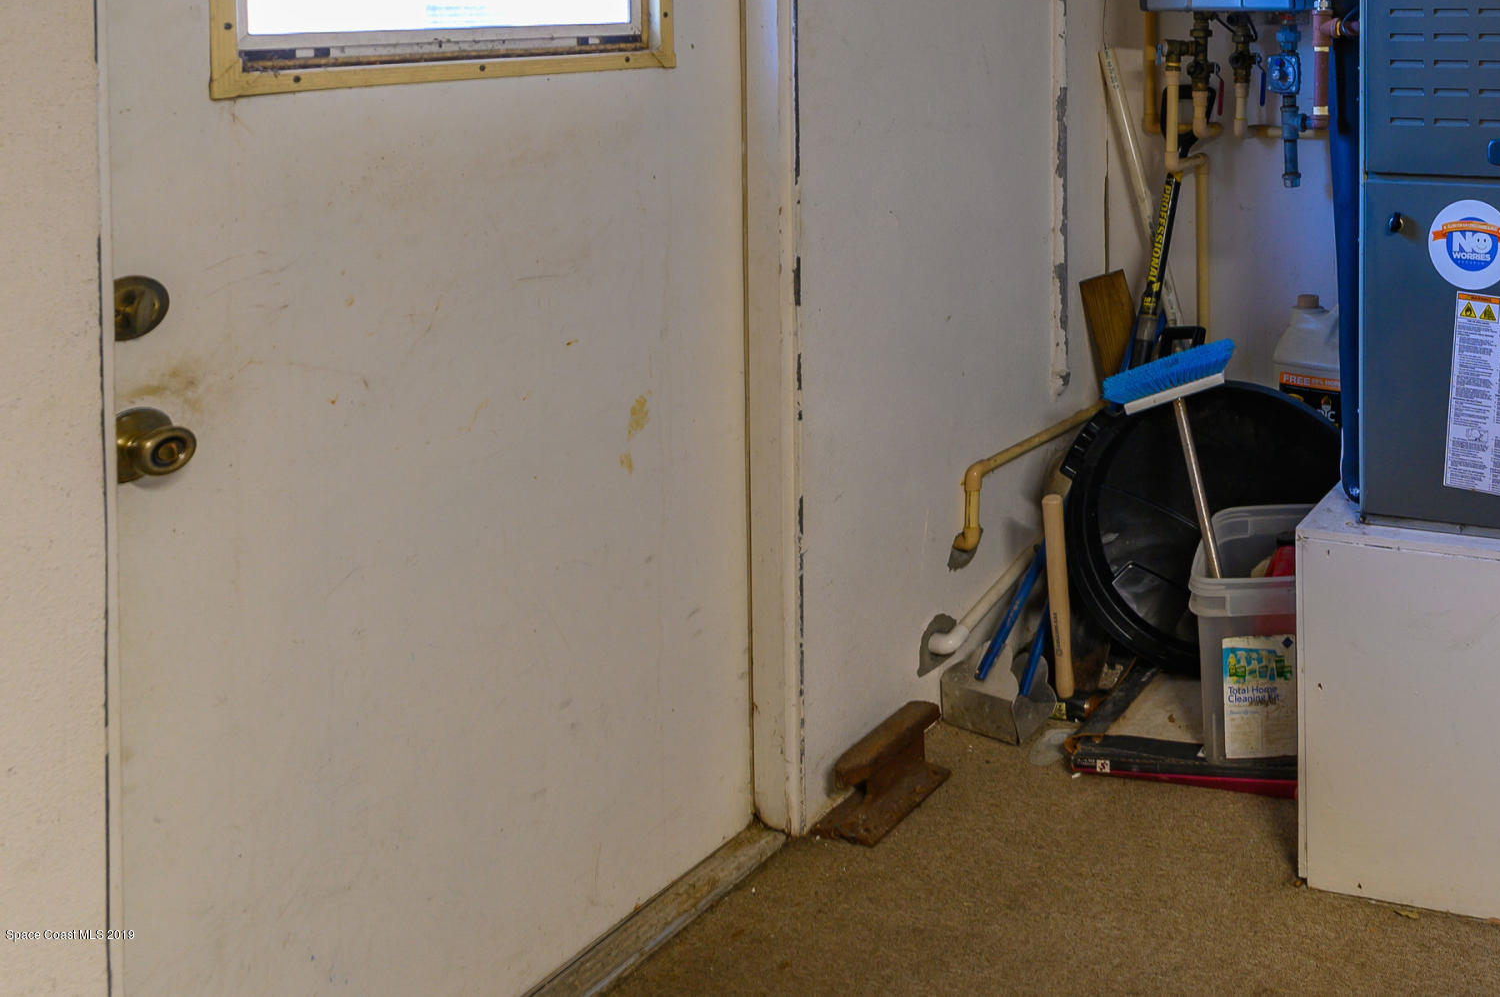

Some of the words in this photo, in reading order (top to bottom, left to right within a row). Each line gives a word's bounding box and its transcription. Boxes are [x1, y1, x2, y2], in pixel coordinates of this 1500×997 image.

[1148, 185, 1172, 283] PROFESSIONAL
[1452, 231, 1493, 254] NO
[1452, 251, 1491, 261] WORRIES
[1283, 373, 1311, 386] FREE
[1228, 686, 1249, 695] Total
[1252, 686, 1278, 694] Home
[1228, 694, 1265, 704] Cleaning
[1268, 694, 1280, 702] Kit
